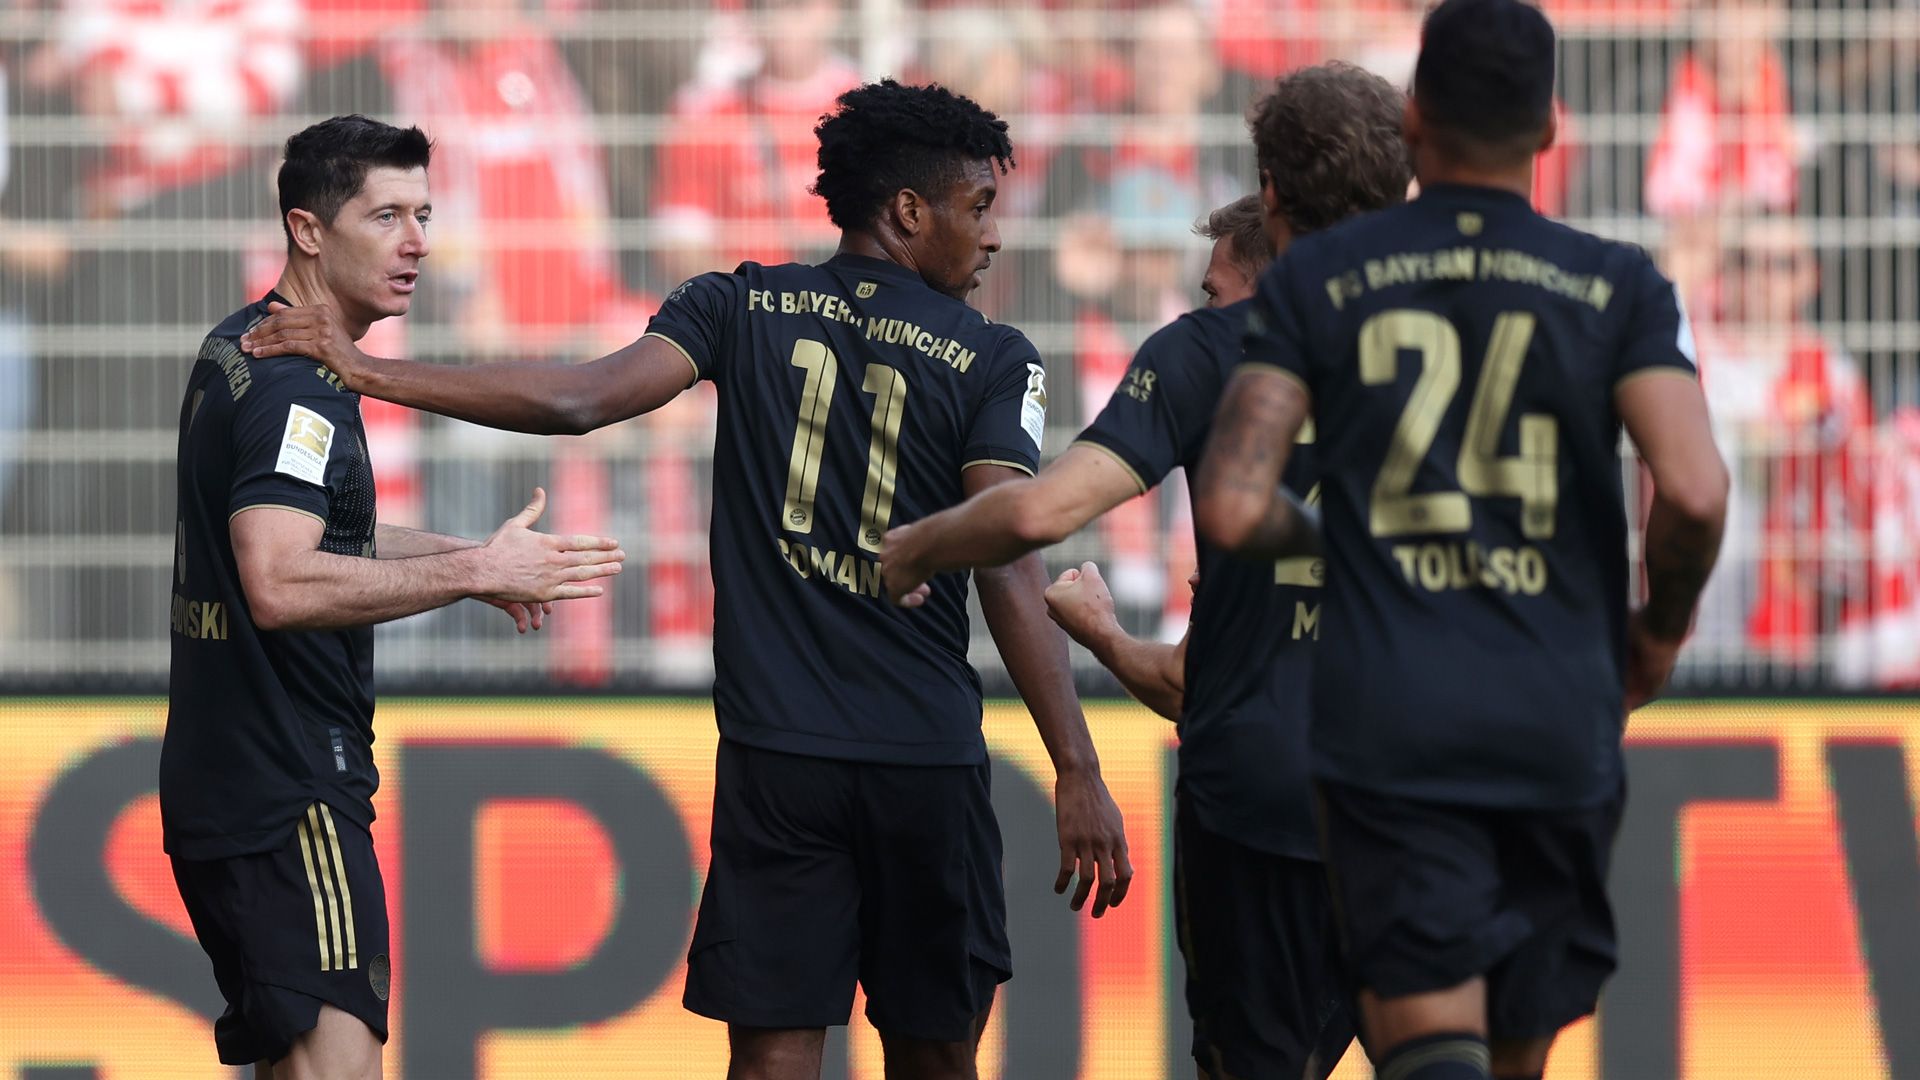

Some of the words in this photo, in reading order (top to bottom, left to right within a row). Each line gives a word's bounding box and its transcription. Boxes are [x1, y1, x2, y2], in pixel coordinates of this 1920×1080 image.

[748, 289, 775, 313] FC
[865, 317, 976, 373] MÜNCHEN
[1358, 309, 1558, 539] 24
[782, 338, 907, 553] 11
